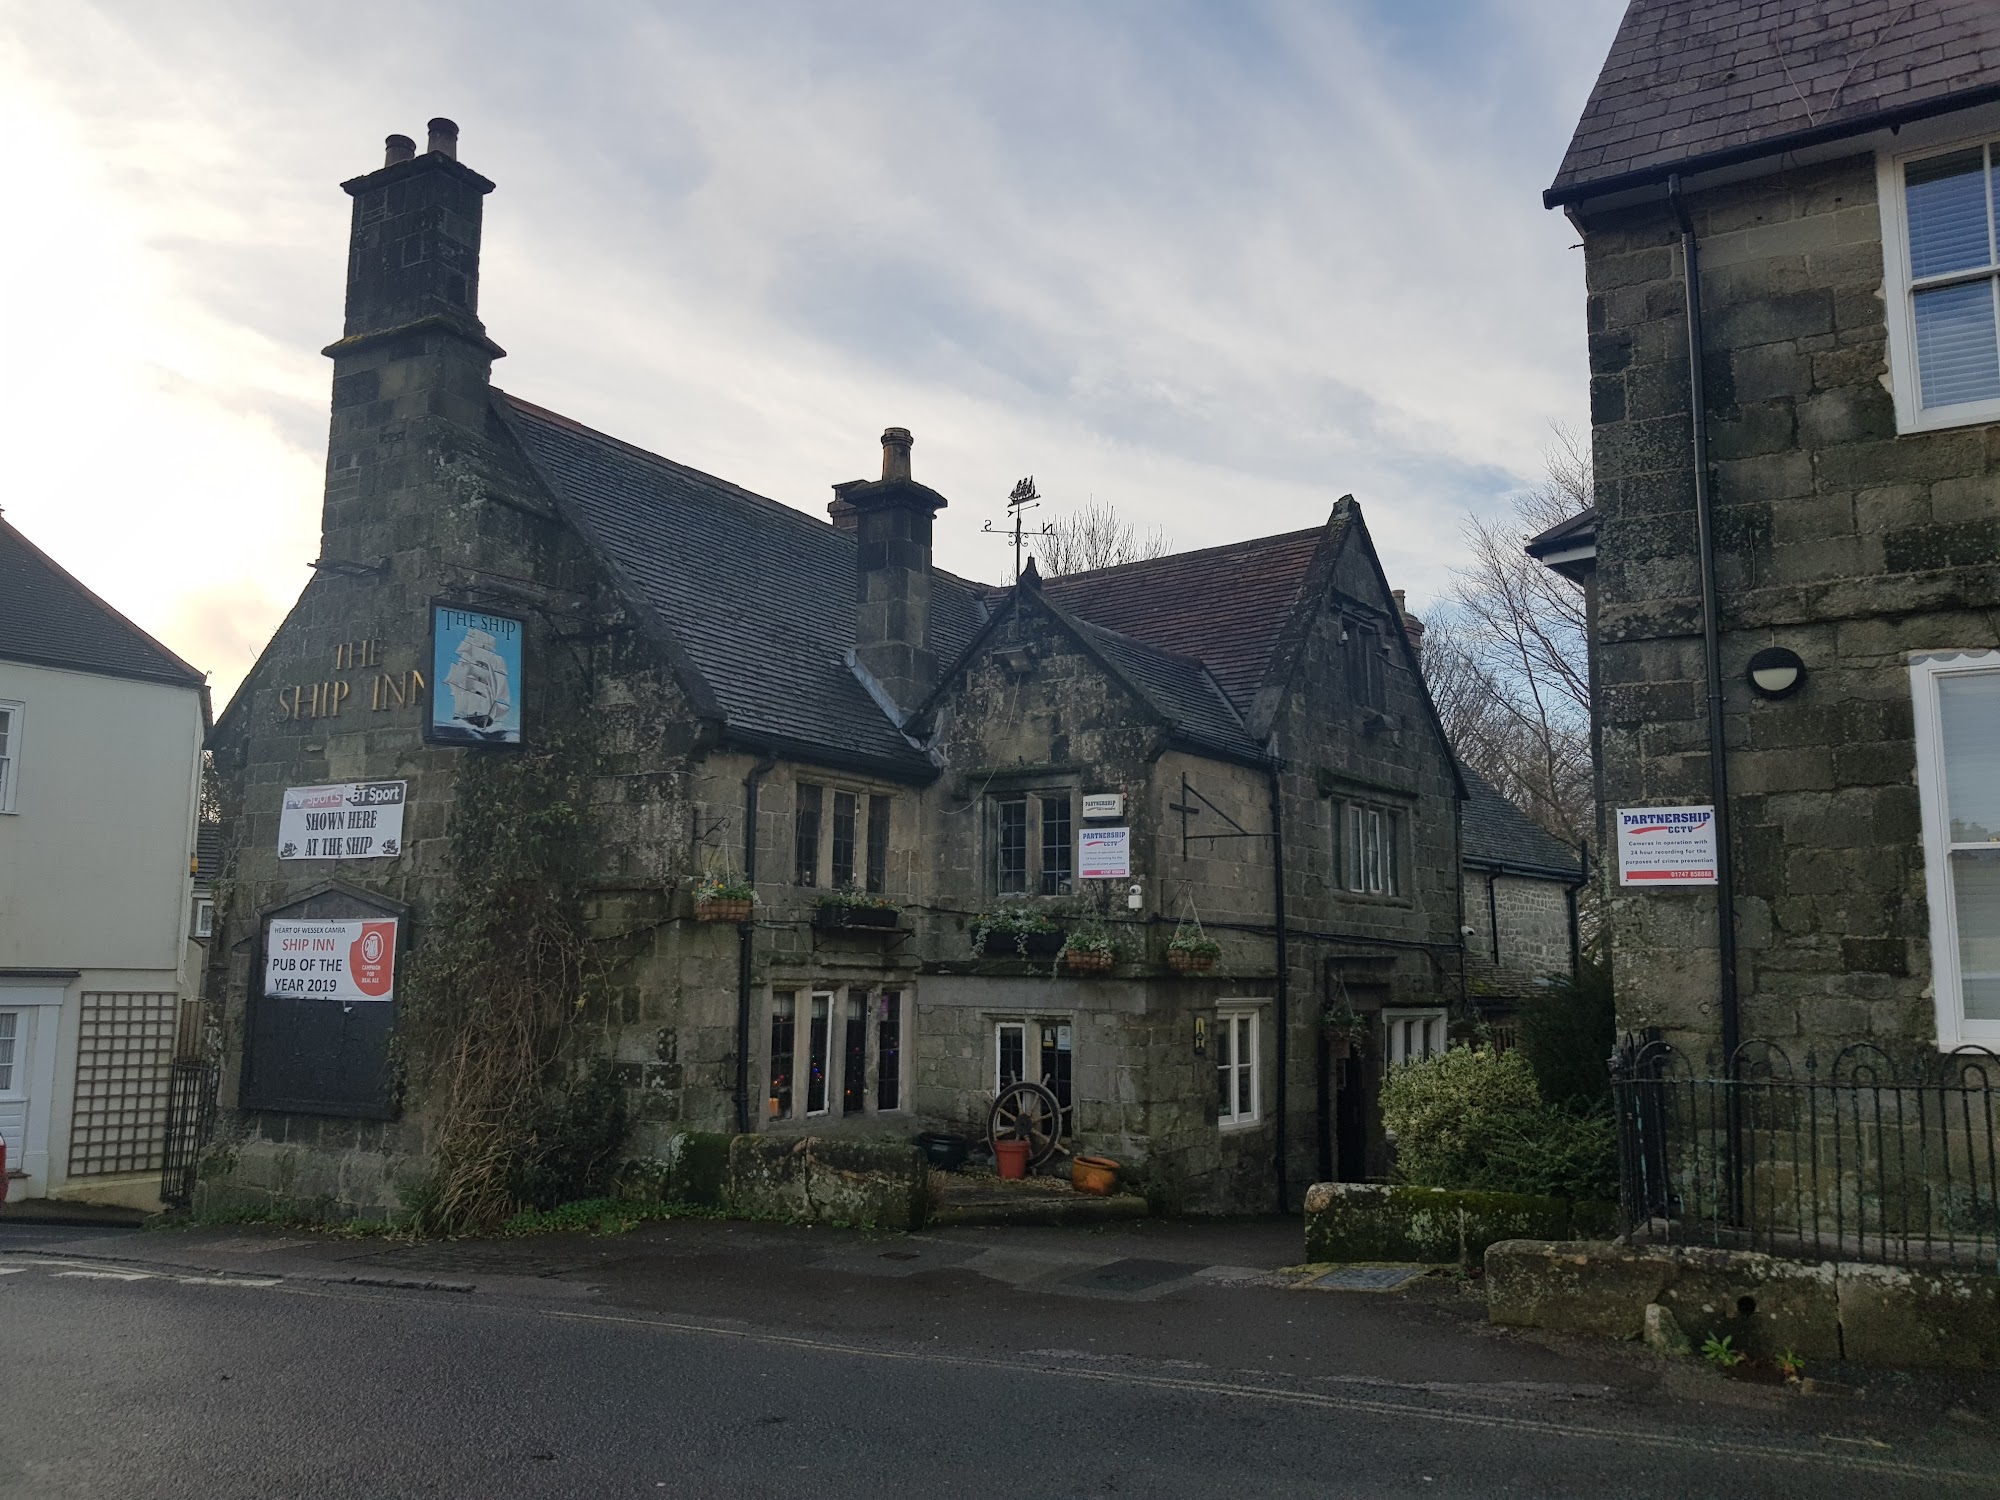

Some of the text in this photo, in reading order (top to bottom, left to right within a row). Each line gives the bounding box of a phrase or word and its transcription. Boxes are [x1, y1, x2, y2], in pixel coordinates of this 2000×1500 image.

[441, 609, 516, 640] THE SHIP
[334, 638, 381, 670] THE
[277, 680, 350, 722] SHIP
[350, 786, 400, 804] BT Sport
[305, 810, 378, 831] SHOWN HERE
[1623, 812, 1711, 825] PARTNERSHIP
[1083, 831, 1126, 840] PARTNERSHIP
[304, 836, 373, 856] AT THE SHIP
[1663, 839, 1693, 847] operation
[1655, 848, 1684, 856] recording
[1680, 857, 1714, 865] prevention
[324, 926, 346, 934] CAMRA
[282, 939, 335, 951] SHIP INN
[272, 958, 343, 972] PUB OF THE
[274, 978, 337, 992] YEAR 2019
